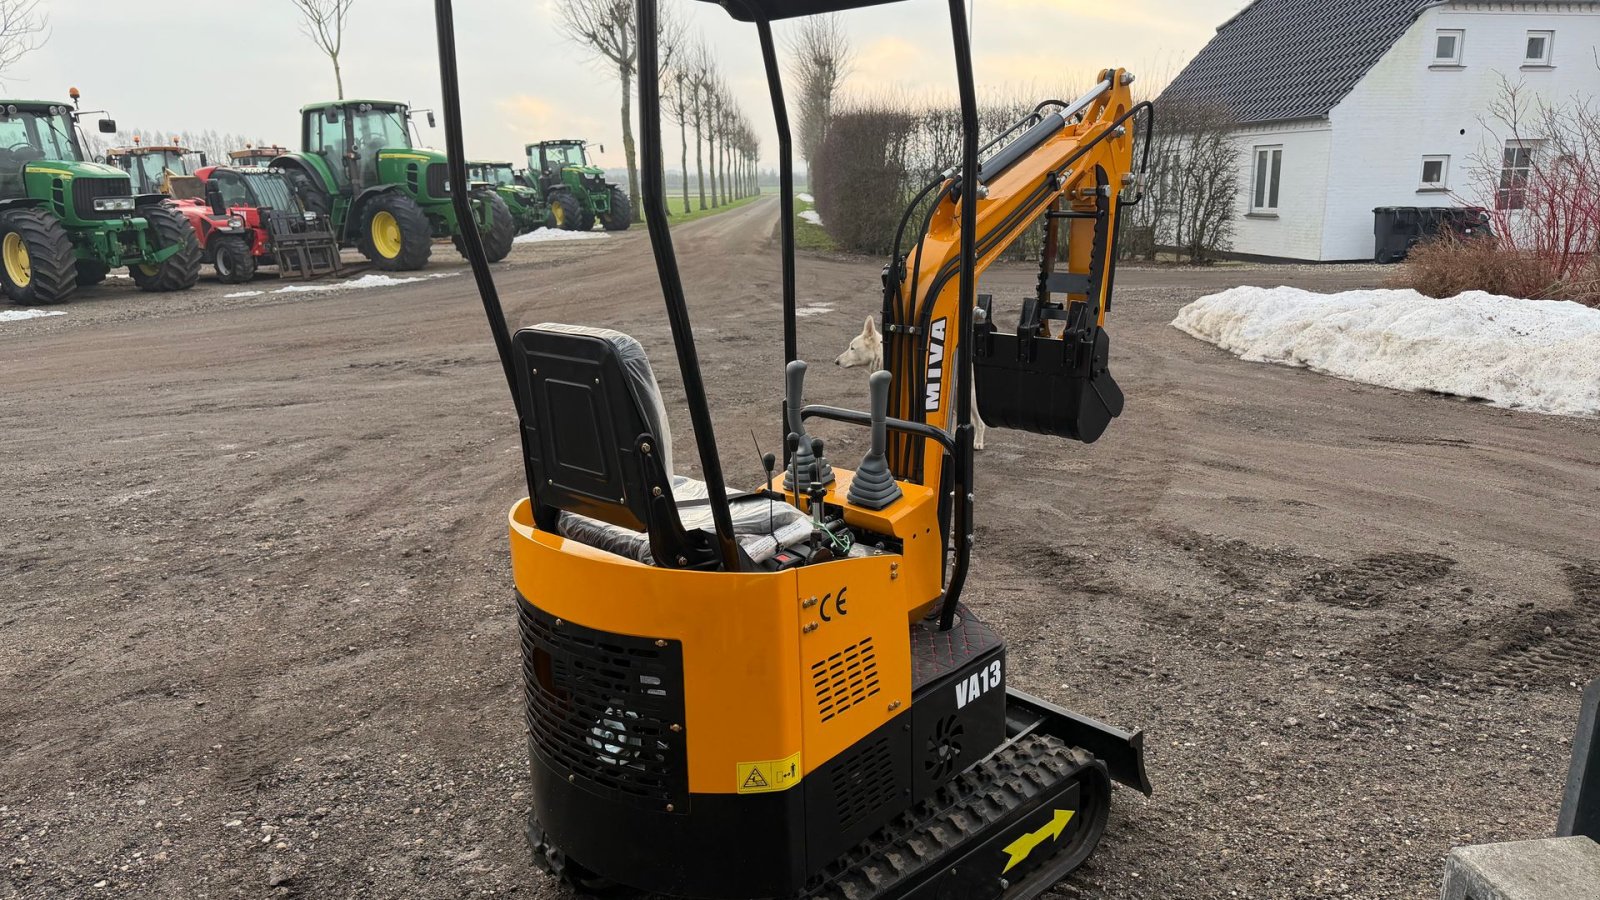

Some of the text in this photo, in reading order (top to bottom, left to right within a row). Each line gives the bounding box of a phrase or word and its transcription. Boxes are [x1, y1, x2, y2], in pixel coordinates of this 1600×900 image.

[925, 319, 946, 410] MIVA
[820, 586, 847, 622] CE
[955, 660, 1001, 709] VA13
